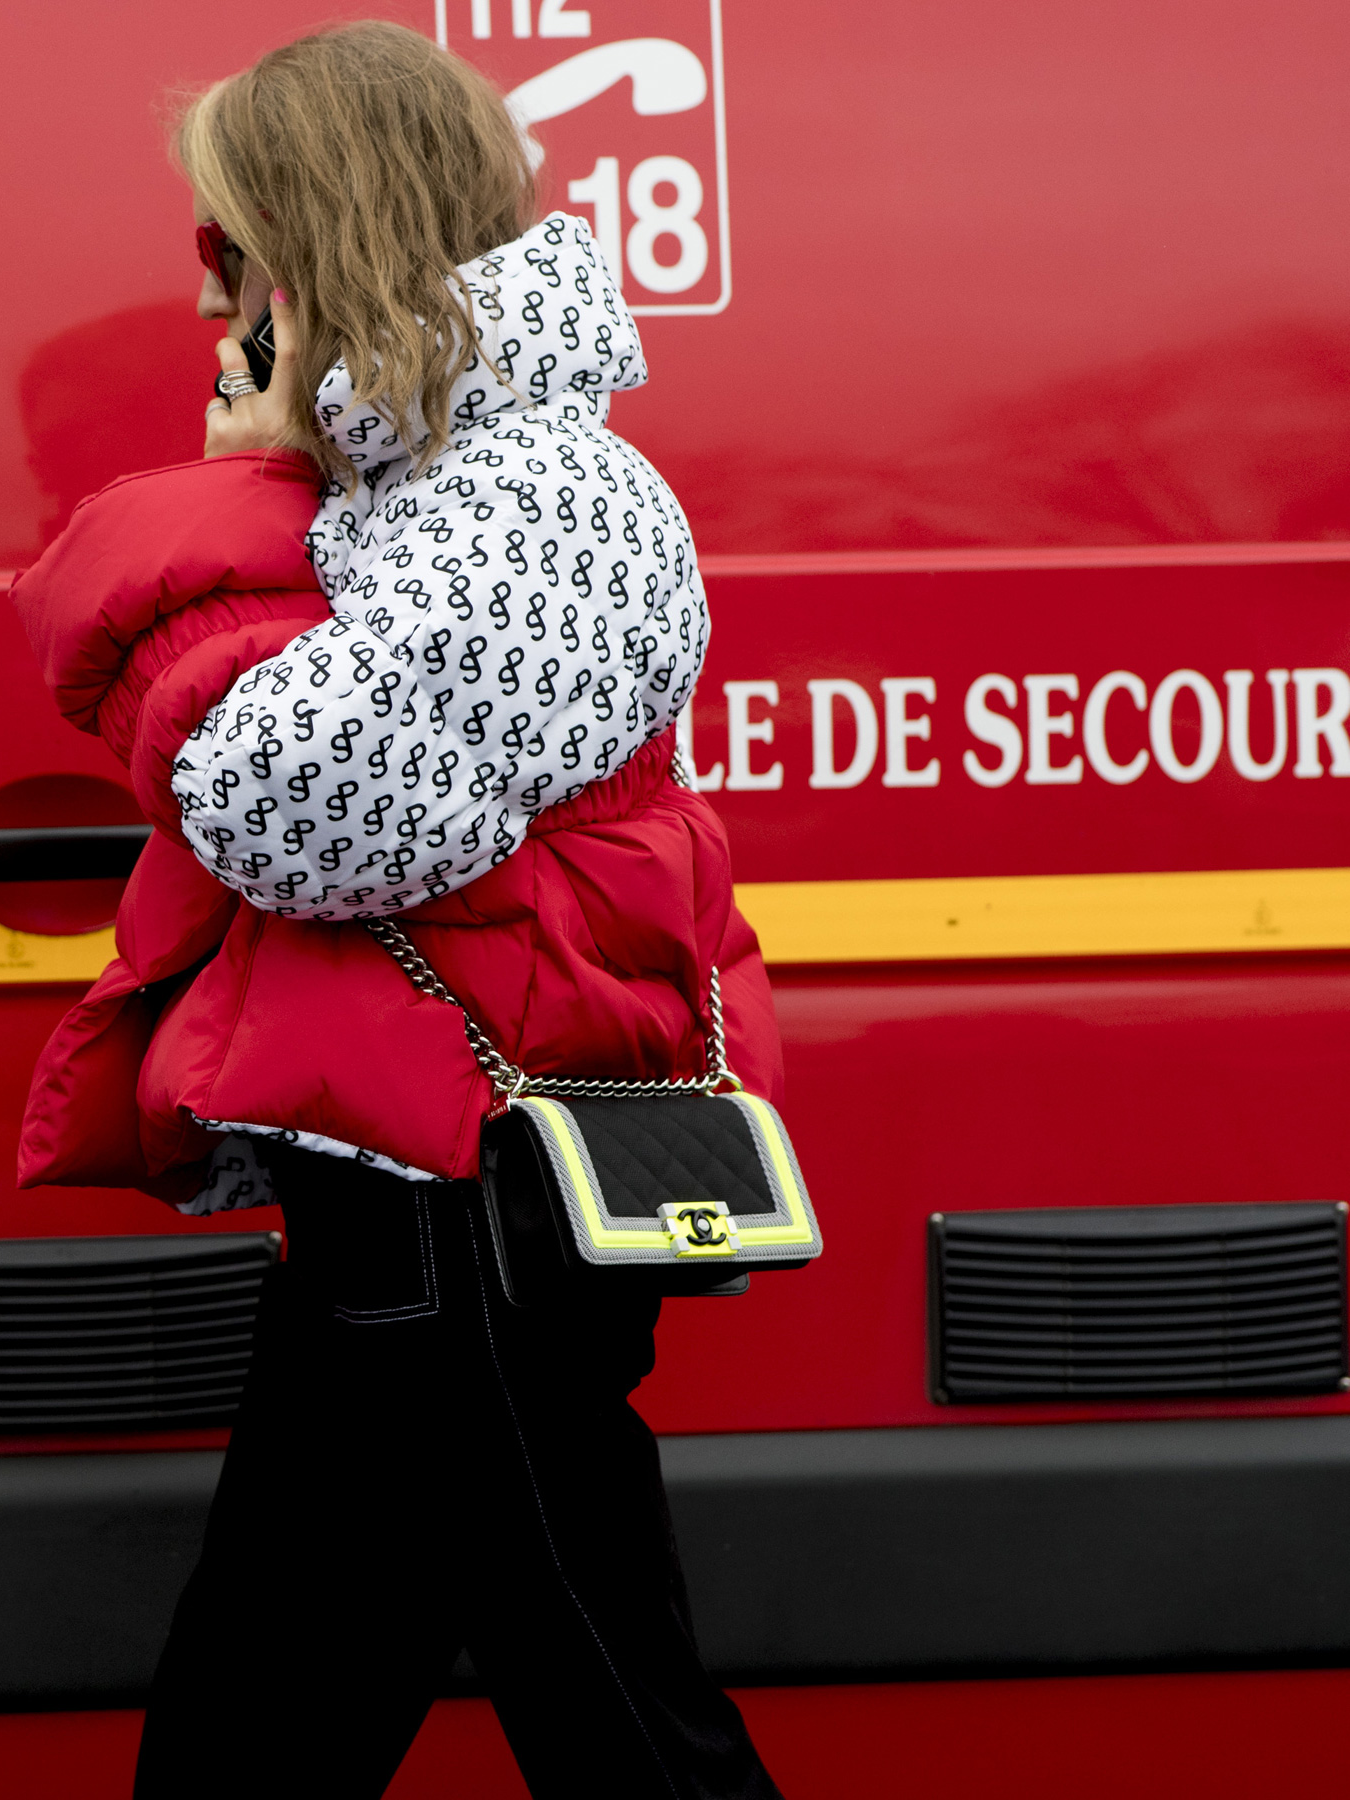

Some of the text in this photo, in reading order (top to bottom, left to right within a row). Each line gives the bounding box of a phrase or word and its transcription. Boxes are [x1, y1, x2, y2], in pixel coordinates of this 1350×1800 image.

[568, 156, 708, 293] 18
[807, 677, 940, 788] DE
[964, 668, 1350, 787] SECOUR
